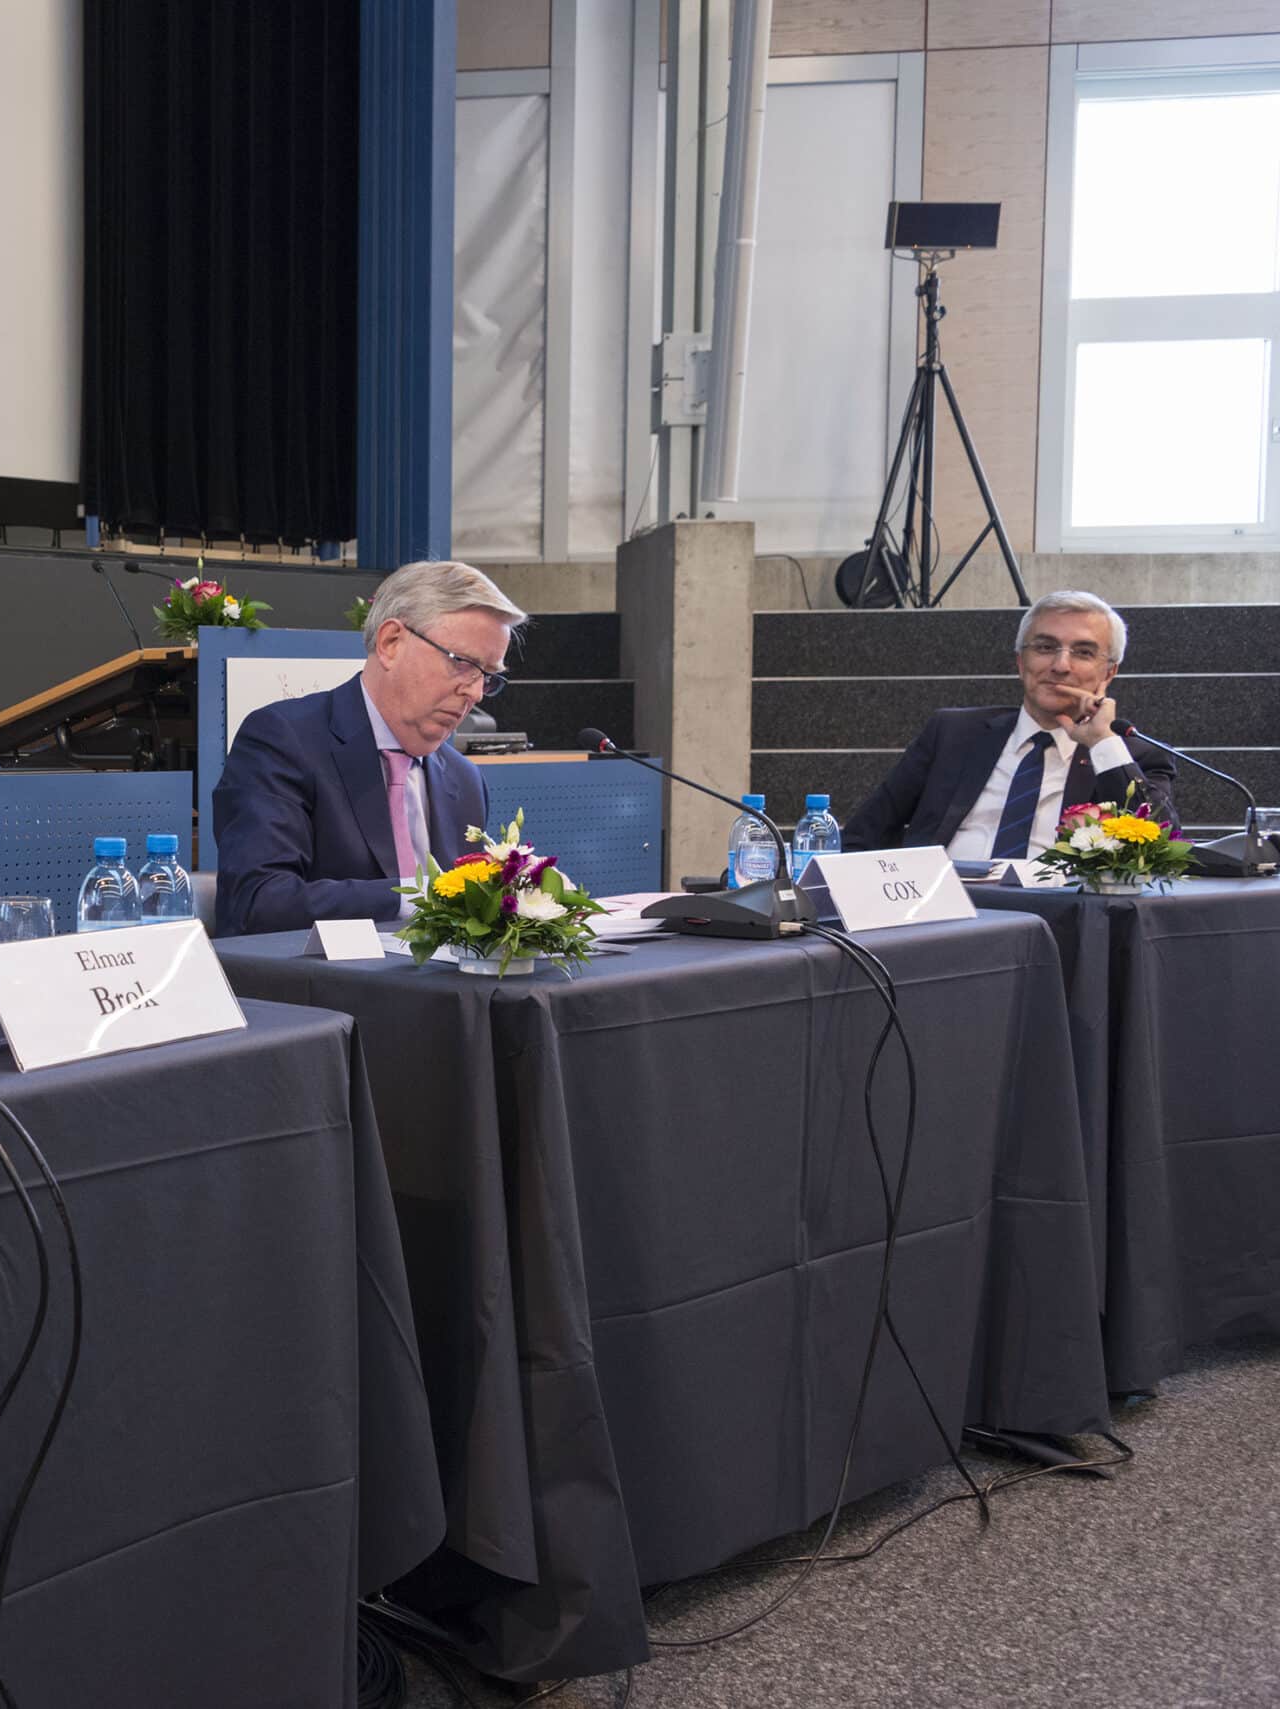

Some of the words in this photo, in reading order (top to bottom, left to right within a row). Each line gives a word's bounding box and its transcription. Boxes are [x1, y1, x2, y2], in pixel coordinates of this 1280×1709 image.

[878, 859, 899, 874] Pat
[882, 880, 924, 903] COX
[74, 948, 137, 972] Elmar
[89, 981, 160, 1016] Brok
